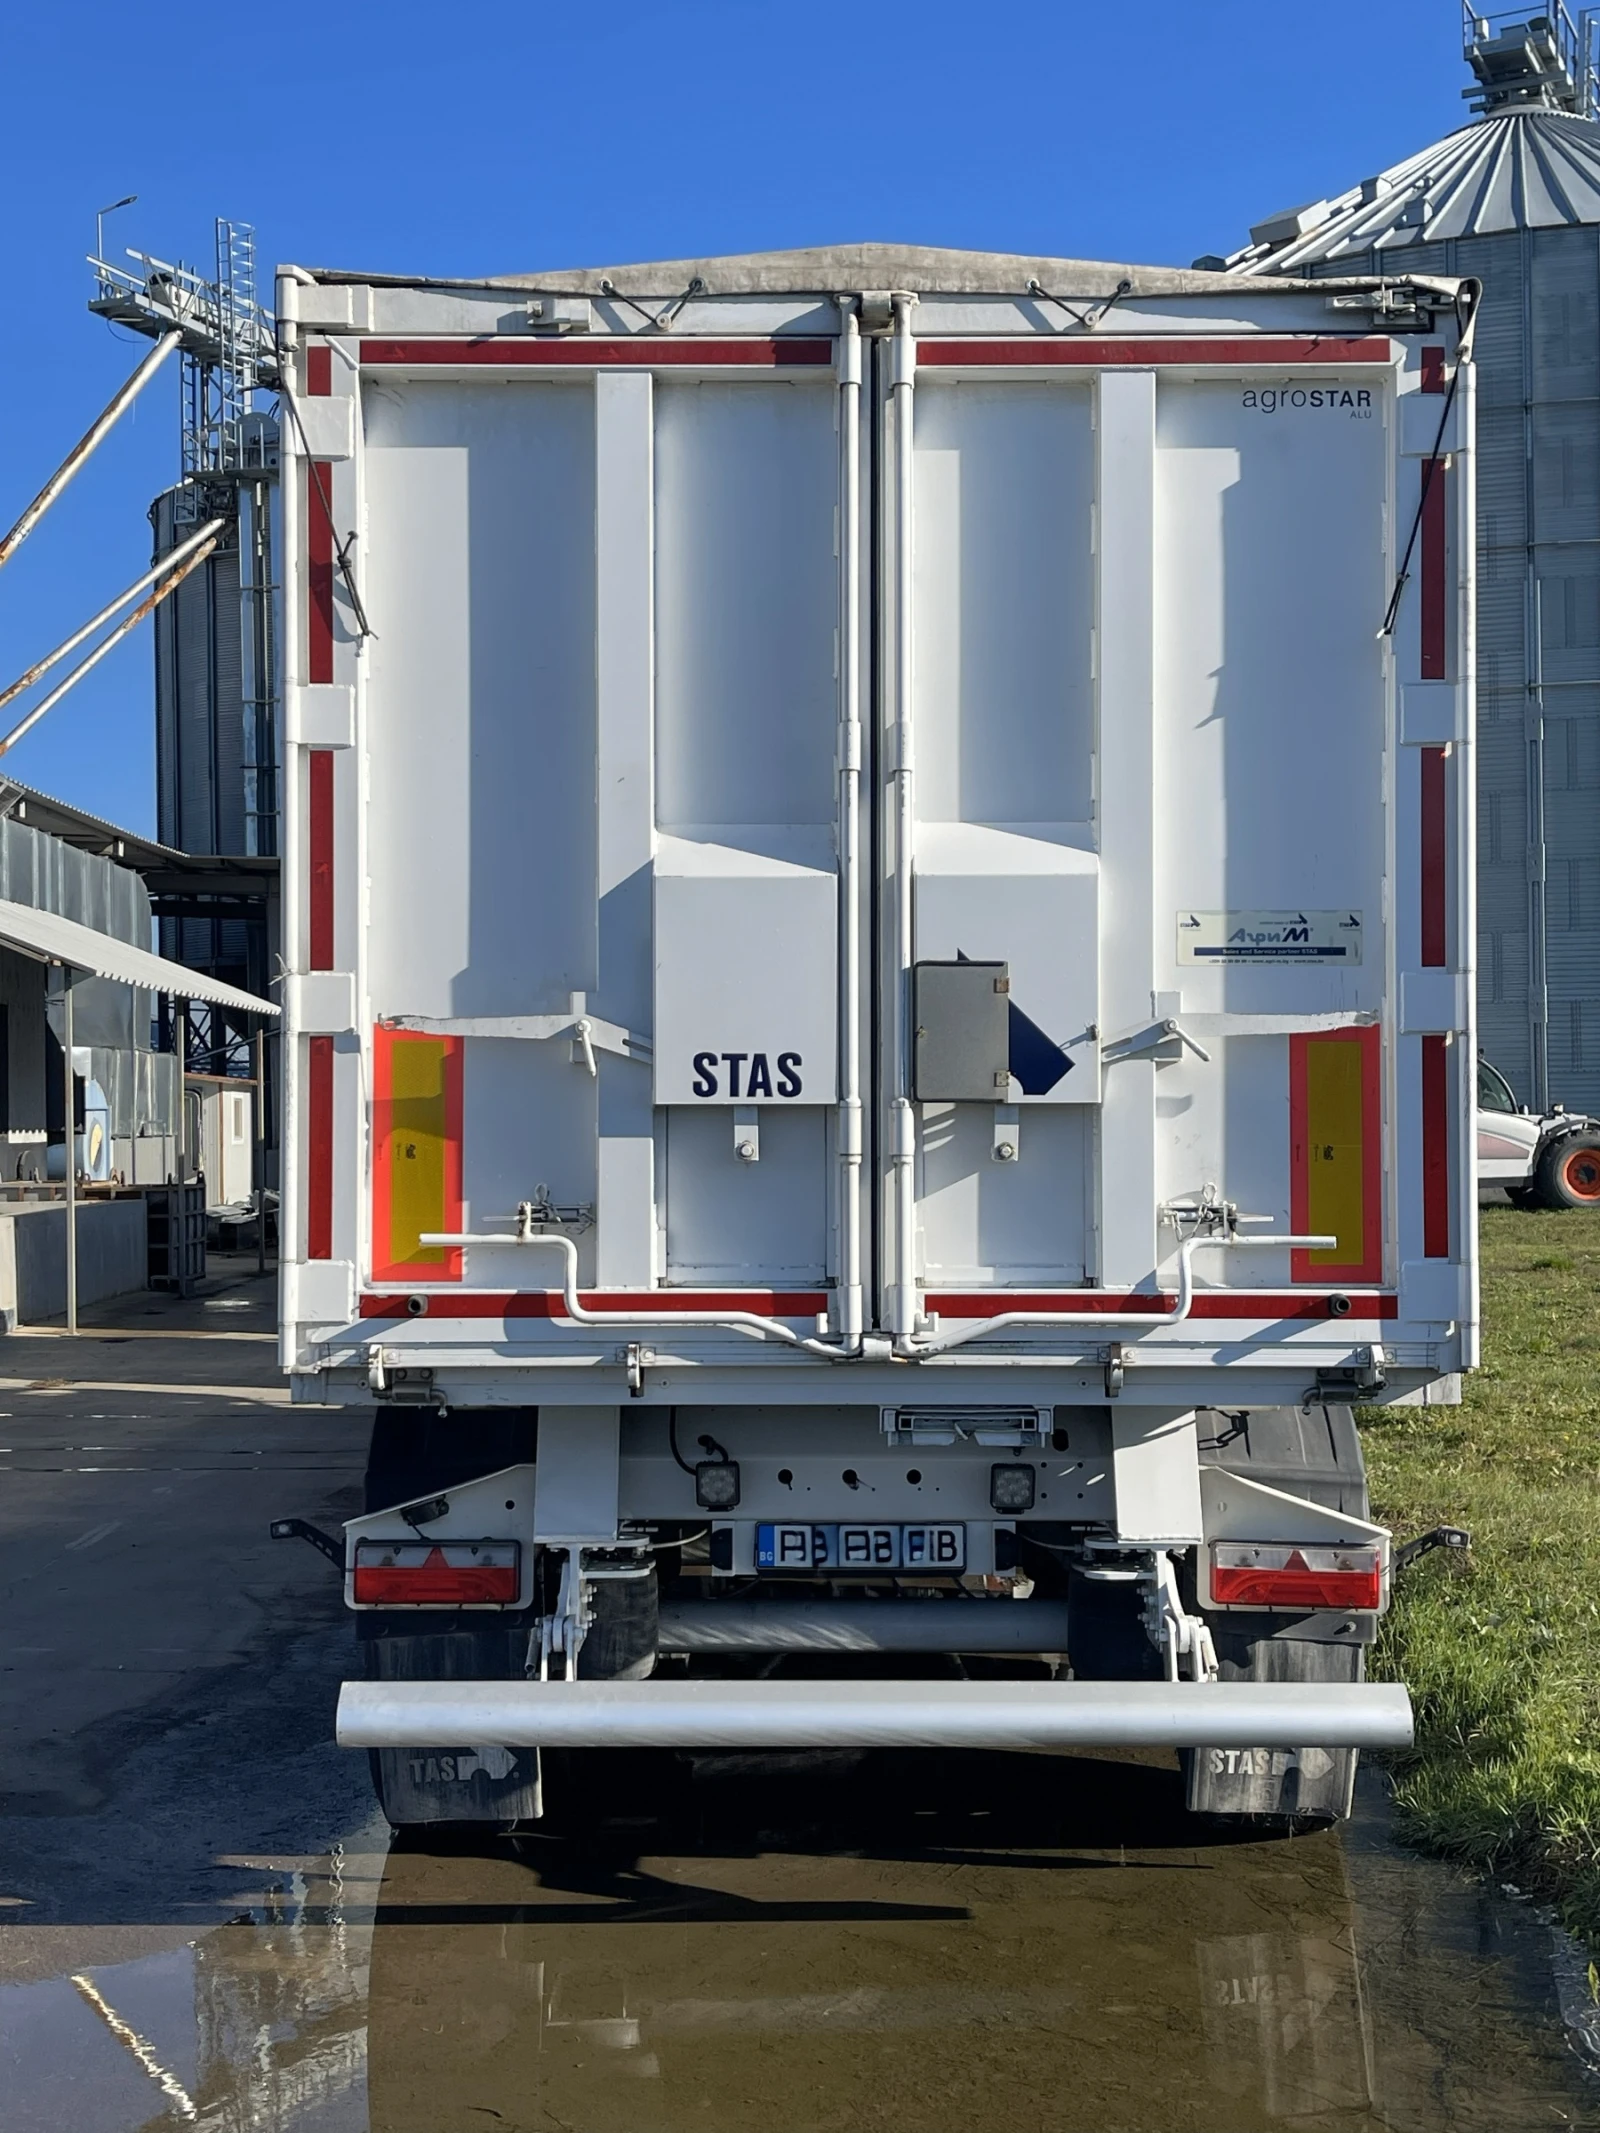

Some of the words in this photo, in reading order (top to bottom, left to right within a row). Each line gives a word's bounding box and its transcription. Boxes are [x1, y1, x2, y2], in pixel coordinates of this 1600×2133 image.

[1242, 390, 1371, 414] agroSTAR
[1350, 410, 1372, 419] ALU
[1277, 948, 1300, 956] partner
[692, 1051, 803, 1098] STAS
[759, 1551, 773, 1561] BG
[1209, 1748, 1270, 1775] STAS
